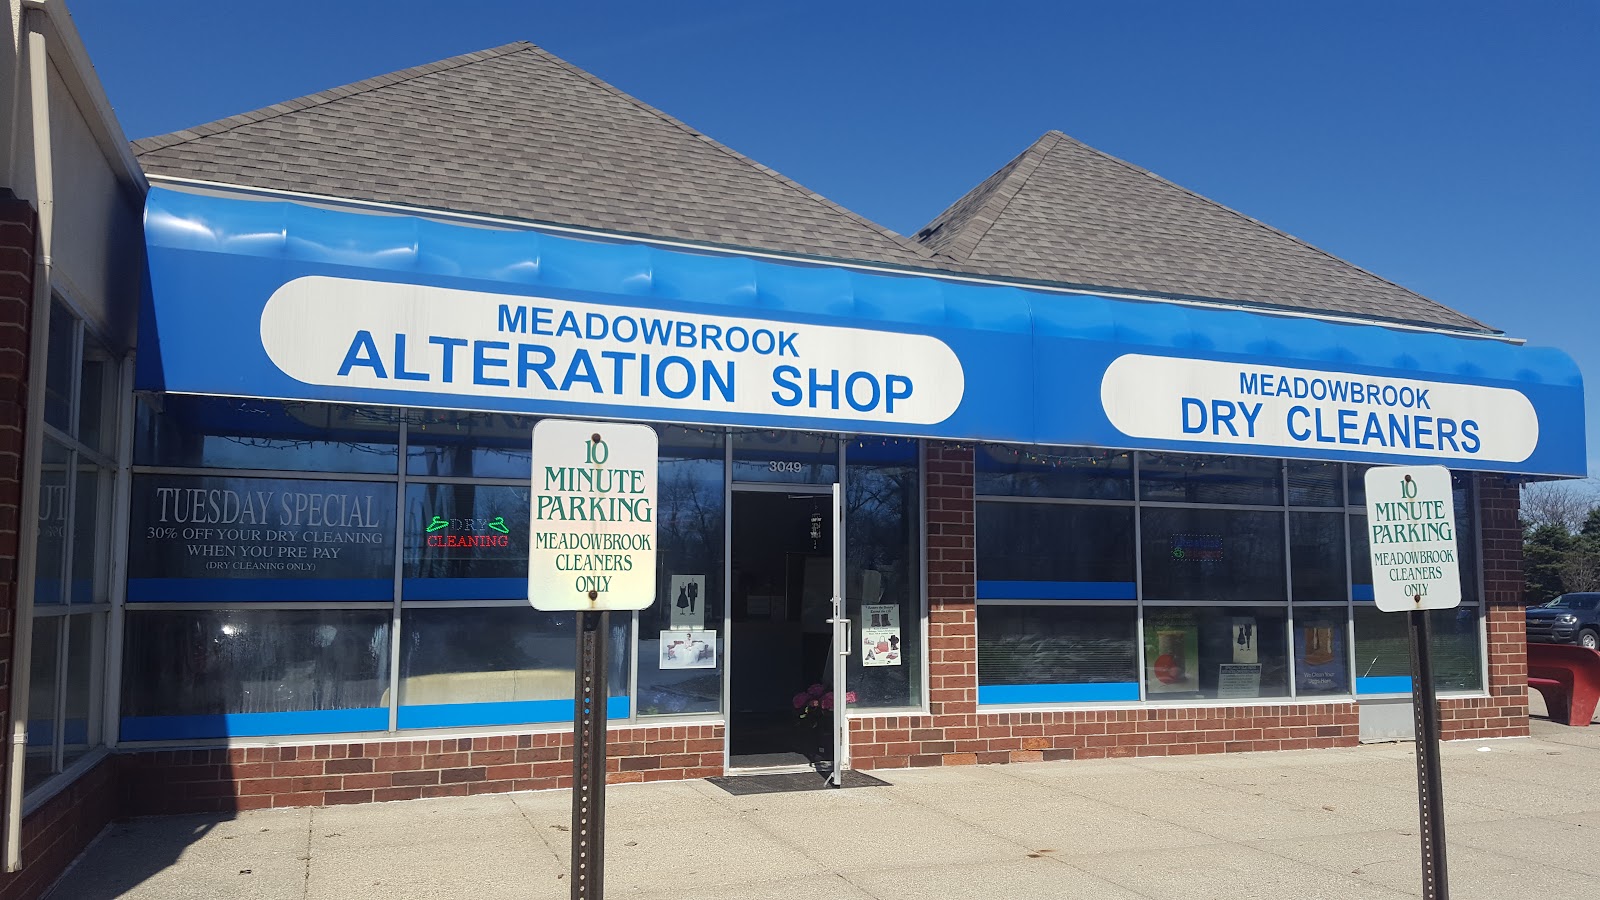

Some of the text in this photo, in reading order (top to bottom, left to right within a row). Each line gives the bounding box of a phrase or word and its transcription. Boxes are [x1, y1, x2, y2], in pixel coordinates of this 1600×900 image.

[498, 304, 800, 358] MEADOWBROOK
[337, 329, 914, 414] ALTERATION SHOP
[1239, 372, 1431, 409] MEADOWBROOK
[1181, 397, 1481, 454] DRY CLEANERS
[584, 440, 609, 465] 10
[769, 460, 802, 473] 3049
[544, 466, 646, 494] MINUTE
[1400, 479, 1418, 499] 10
[156, 487, 379, 529] TUESDAY SPECIAL
[536, 495, 653, 523] PARKING
[1375, 500, 1446, 522] MINUTE
[450, 518, 487, 531] DRY
[1372, 522, 1453, 544] PARKING
[147, 526, 383, 544] 30% OFF YOUR DRY CLEANING
[427, 535, 509, 547] CLEANING
[535, 532, 652, 551] MEADOWBROOK
[186, 544, 341, 559] WHEN YOU PRE PAY
[1374, 549, 1455, 566] MEADOWBROOK
[205, 561, 316, 571] (DRY CLEANING ONLY)
[555, 554, 633, 571] CLEANERS
[1389, 566, 1443, 581] CLEANERS
[575, 575, 612, 593] ONLY
[1404, 583, 1429, 597] ONLY
